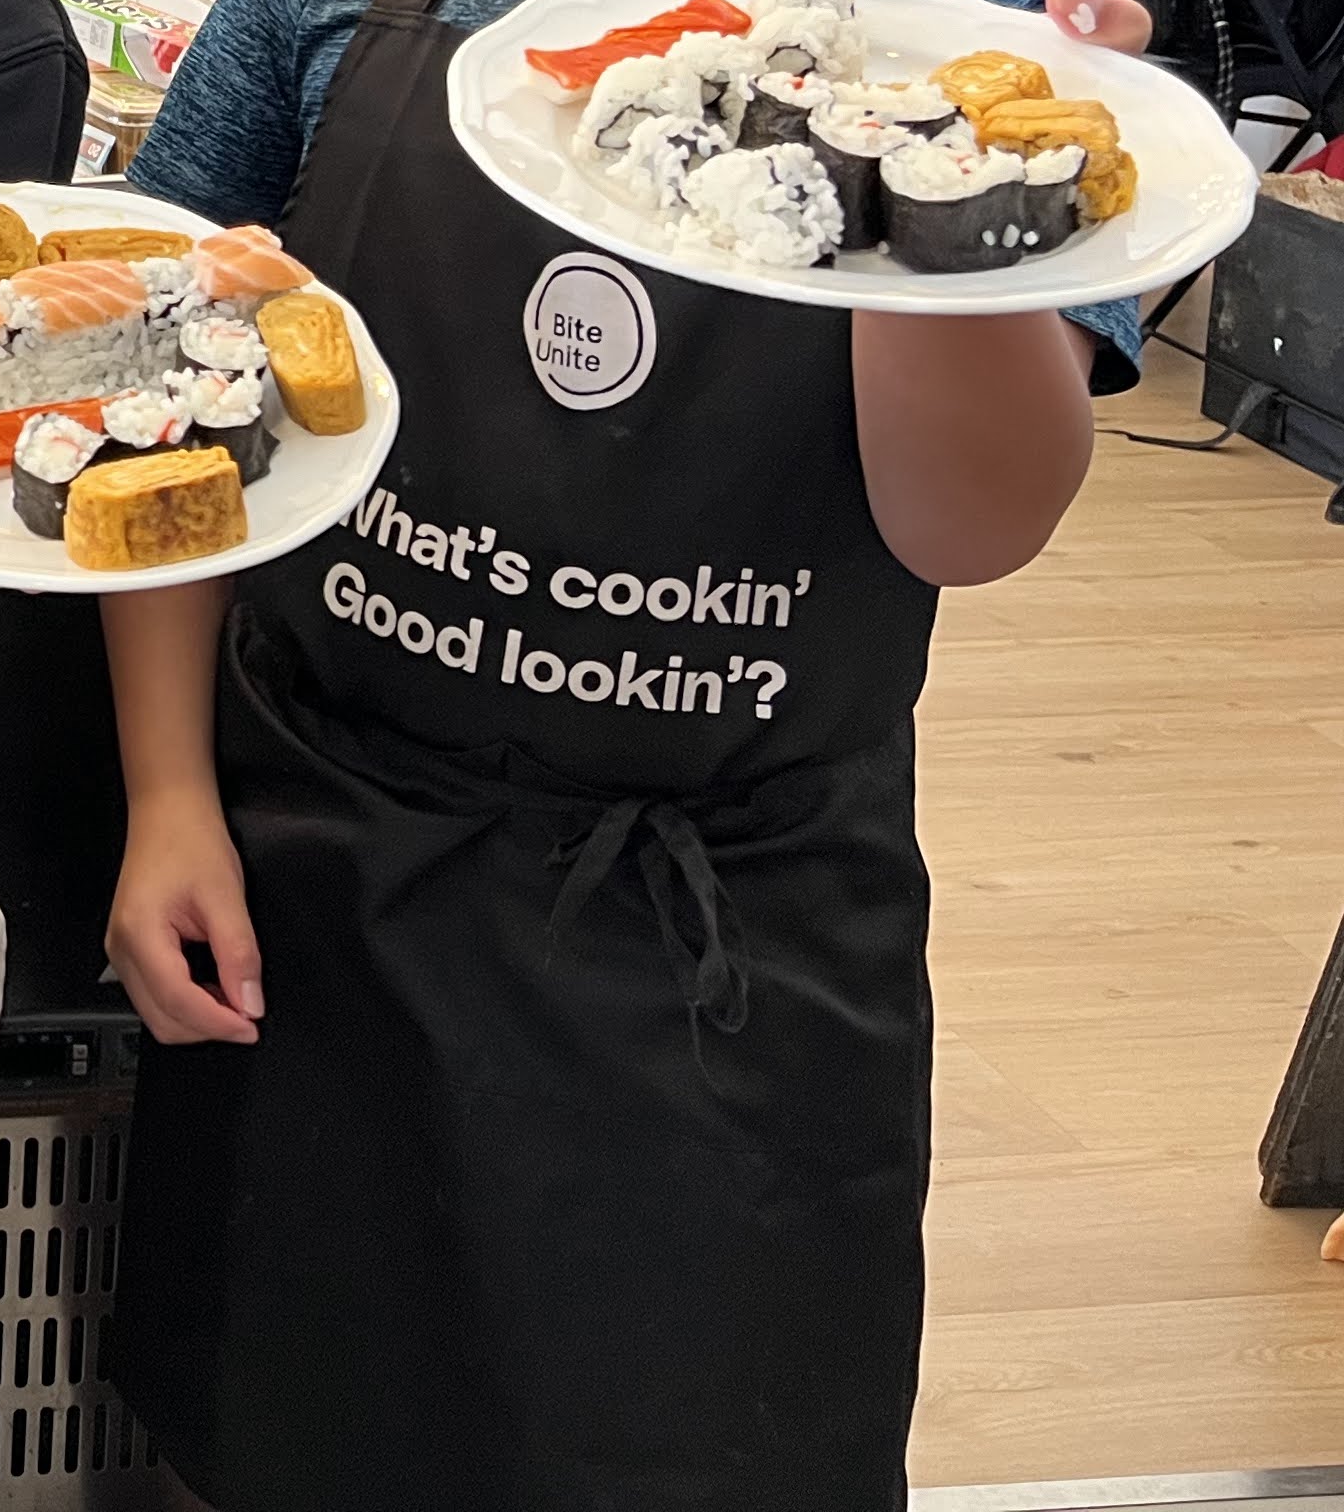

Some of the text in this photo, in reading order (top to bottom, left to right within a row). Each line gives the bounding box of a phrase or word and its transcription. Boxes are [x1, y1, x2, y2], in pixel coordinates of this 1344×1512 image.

[535, 338, 601, 372] Unite
[553, 313, 602, 344] Bite
[339, 487, 812, 628] What's cookin'
[322, 562, 788, 720] Good lookin'?
